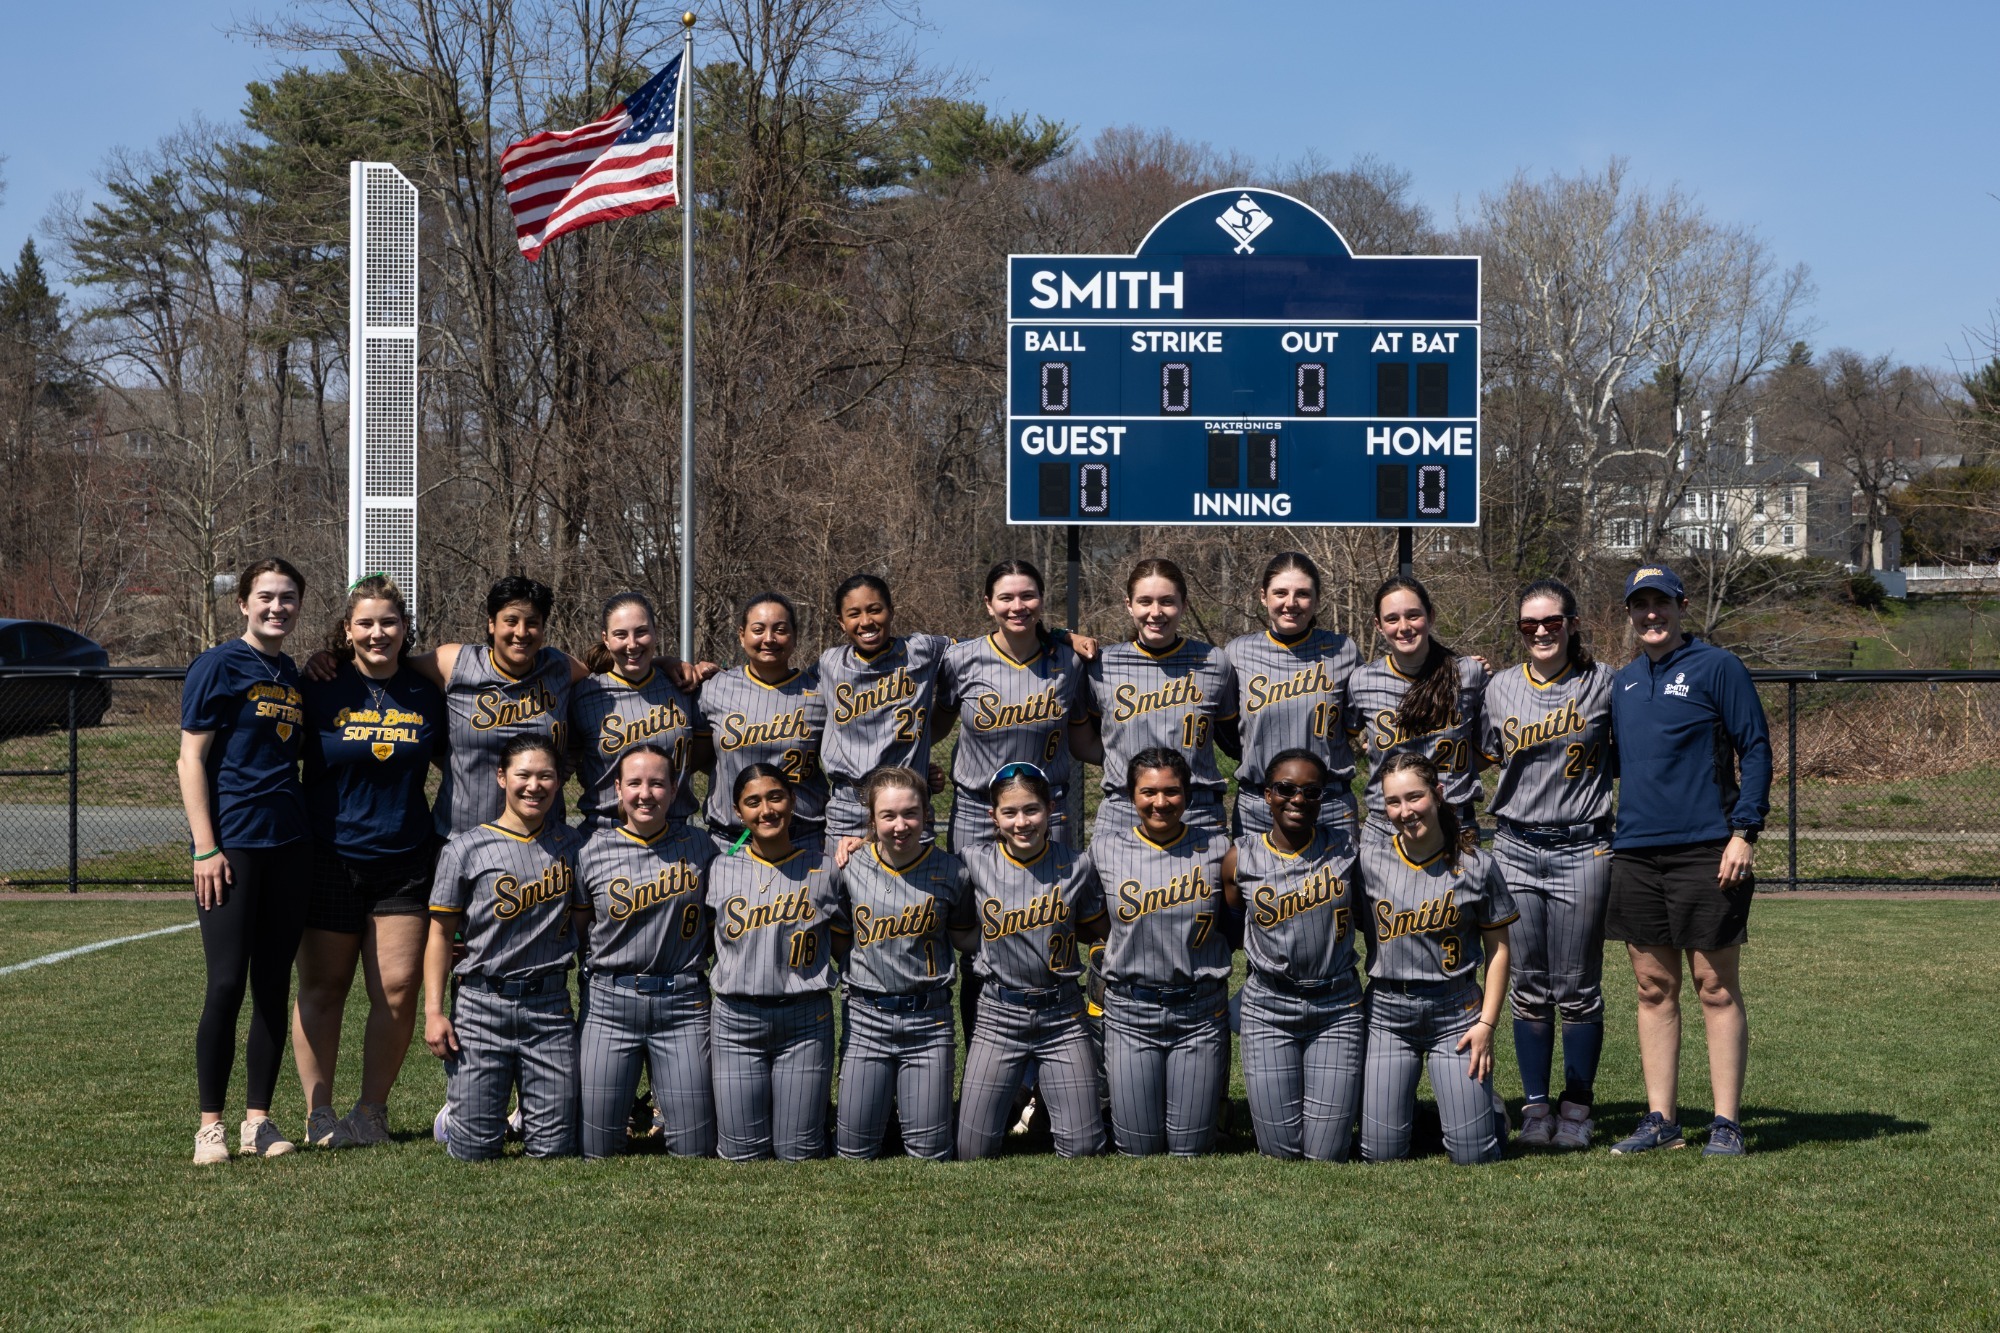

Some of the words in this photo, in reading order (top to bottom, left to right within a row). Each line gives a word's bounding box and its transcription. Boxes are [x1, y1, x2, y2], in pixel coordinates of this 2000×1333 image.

[1029, 270, 1184, 309] SMITH
[1025, 331, 1086, 351] BALL
[1131, 331, 1223, 353] STRIKE
[1281, 331, 1339, 353] OUT
[1370, 332, 1403, 353] AT
[1411, 332, 1460, 353] BAT
[1042, 362, 1069, 411] 0
[1162, 363, 1190, 412] 0
[1297, 363, 1325, 412] 0
[1020, 425, 1127, 456] GUEST
[1205, 422, 1282, 430] DAKTRONICS
[1366, 426, 1473, 456] HOME
[1081, 463, 1108, 512] 0
[1193, 492, 1292, 517] INNING
[1418, 465, 1446, 514] 0
[471, 679, 556, 731] Smith
[834, 667, 916, 724] Smith
[1114, 672, 1203, 722] Smith
[1246, 662, 1334, 713] Smith
[1664, 683, 1690, 693] SMITH
[333, 707, 382, 727] Smith
[381, 708, 424, 726] Bears
[602, 697, 688, 753] Smith
[974, 687, 1063, 731] Smith
[1314, 702, 1341, 739] 12
[1502, 697, 1587, 758] Smith
[342, 725, 420, 743] SOFTBALL
[720, 709, 811, 750] Smith
[1043, 729, 1062, 763] 6
[1182, 712, 1210, 749] 13
[783, 748, 816, 783] 25
[1435, 738, 1469, 773] 20
[1564, 742, 1600, 779] 24
[493, 855, 573, 920] Smith
[608, 856, 699, 921] Smith
[1117, 865, 1211, 922] Smith
[1254, 865, 1345, 929] Smith
[680, 903, 700, 940] 8
[725, 886, 816, 940] Smith
[854, 895, 940, 948] Smith
[982, 885, 1070, 941] Smith
[1192, 912, 1214, 949] 7
[1376, 889, 1462, 945] Smith
[788, 930, 818, 968] 18
[924, 940, 937, 977] 1
[1048, 932, 1076, 971] 21
[1441, 936, 1462, 973] 3
